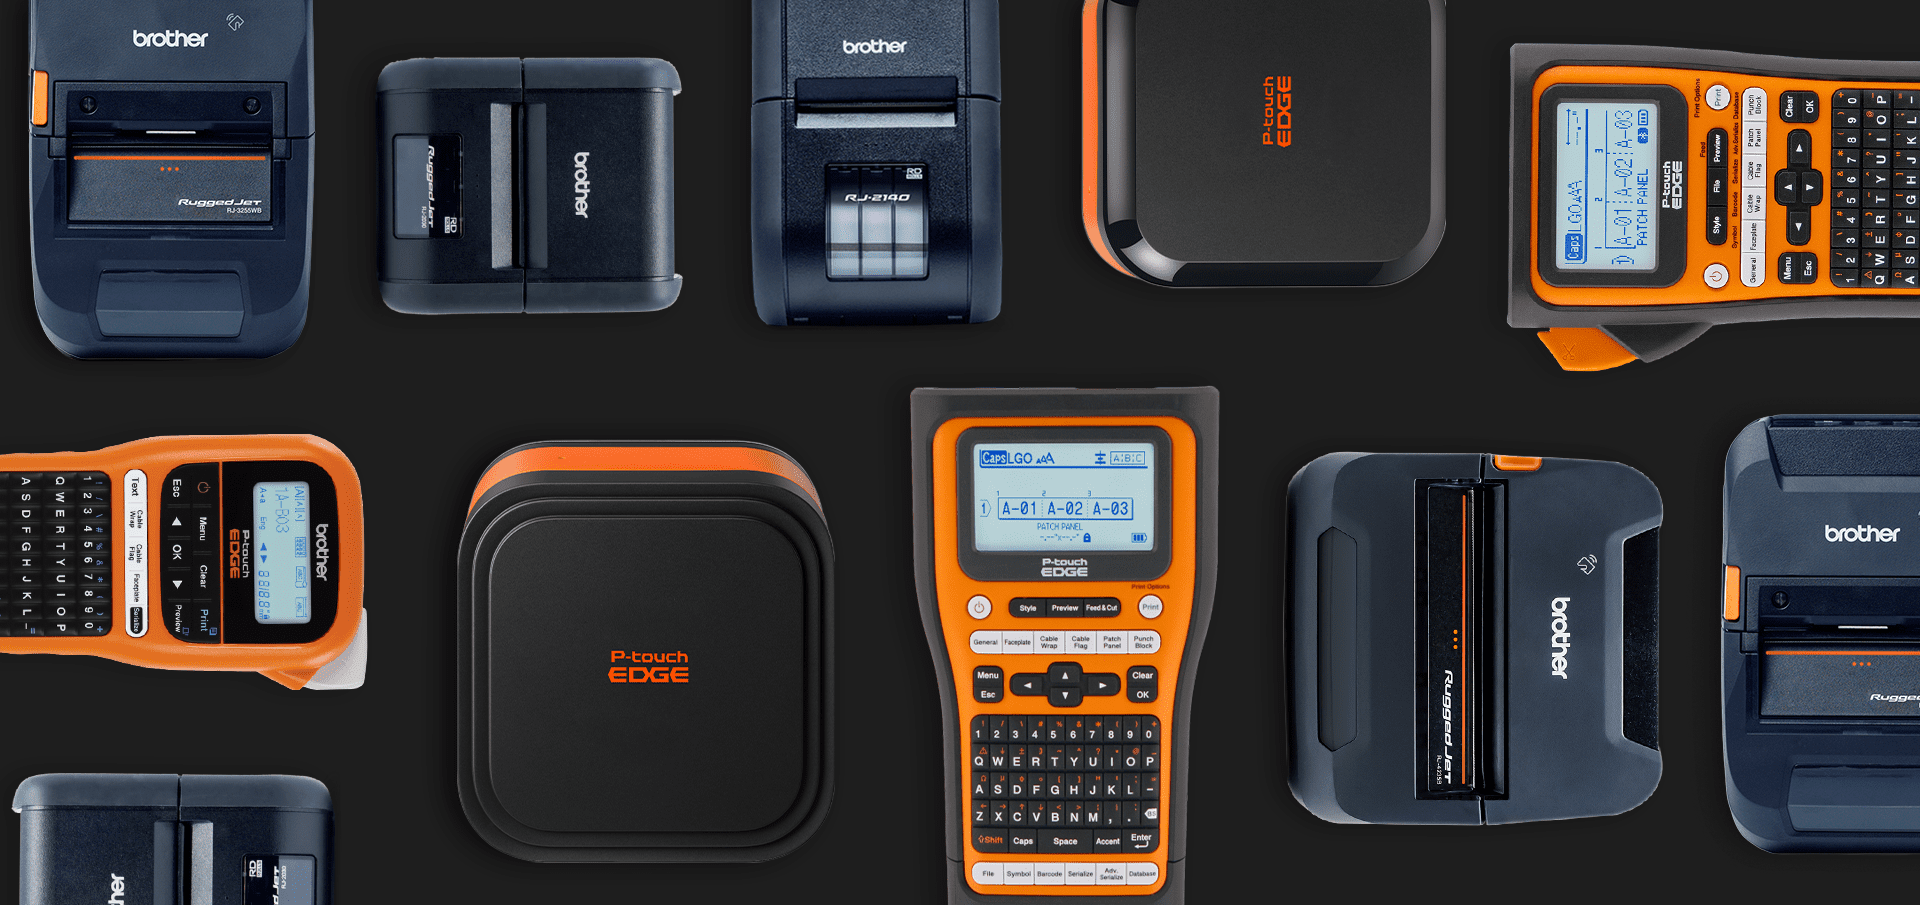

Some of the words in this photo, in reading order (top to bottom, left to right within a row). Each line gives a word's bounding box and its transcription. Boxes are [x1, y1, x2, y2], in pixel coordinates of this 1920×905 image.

[133, 30, 208, 47] brother
[843, 39, 907, 54] brother
[1785, 95, 1794, 118] Clear
[1876, 95, 1887, 104] P
[1263, 76, 1274, 145] P-touch
[1277, 76, 1292, 148] EDGE
[1805, 100, 1814, 114] OK
[1876, 115, 1887, 125] O
[1614, 110, 1633, 149] A-03
[1713, 134, 1721, 162] Preview
[1876, 155, 1887, 164] U
[1614, 158, 1633, 197] A-02
[1662, 161, 1671, 208] P-touch
[1876, 175, 1886, 183] Y
[574, 152, 590, 218] brother
[1637, 168, 1649, 205] PANEL
[1671, 160, 1683, 210] EDGE
[1713, 179, 1721, 193] File
[845, 194, 910, 202] RJ-2140
[450, 217, 457, 233] RD
[1713, 216, 1722, 234] Style
[1875, 215, 1885, 224] R
[1614, 209, 1633, 246] A-01
[1636, 209, 1648, 246] PATCH
[1565, 233, 1583, 260] Caps
[1875, 236, 1885, 244] E
[1875, 253, 1885, 266] W
[1784, 257, 1792, 280] Menu
[1804, 260, 1812, 276] Esc
[1874, 275, 1885, 285] Q
[982, 451, 1007, 465] Caps
[1007, 452, 1033, 464] LGO
[55, 476, 65, 485] Q
[131, 477, 140, 496] Text
[172, 478, 182, 498] Esc
[55, 491, 65, 503] W
[55, 509, 65, 518] E
[1002, 501, 1036, 516] A-01
[1047, 501, 1083, 516] A-02
[1092, 501, 1129, 516] A-03
[55, 526, 65, 534] R
[199, 516, 207, 541] Menu
[259, 516, 267, 530] Eng
[1037, 522, 1060, 531] PATCH
[1061, 522, 1083, 531] PANEL
[1824, 524, 1901, 542] brother
[172, 544, 182, 560] OK
[229, 528, 240, 579] EDGE
[242, 529, 250, 578] P-touch
[315, 523, 329, 581] brother
[56, 558, 66, 566] Y
[1042, 558, 1088, 566] P-touch
[56, 574, 66, 583] U
[200, 564, 208, 589] Clear
[1040, 567, 1089, 577] EDGE
[132, 573, 141, 603] Faceplate
[56, 607, 66, 616] O
[1019, 604, 1037, 612] Style
[1051, 604, 1079, 612] Preview
[174, 604, 182, 633] Preview
[200, 609, 209, 632] Print
[56, 624, 66, 632] P
[1551, 596, 1571, 680] brother
[1040, 642, 1058, 650] Wrap
[1073, 642, 1088, 650] Flag
[611, 650, 689, 663] P-touch
[608, 666, 689, 683] EDGE
[977, 671, 999, 679] Menu
[1132, 671, 1153, 679] Clear
[1136, 691, 1149, 699] OK
[974, 757, 984, 767] Q
[992, 757, 1004, 767] W
[1013, 757, 1021, 767] E
[1032, 757, 1040, 767] R
[1051, 757, 1059, 767] T
[1070, 757, 1079, 767] Y
[1089, 757, 1098, 767] U
[1126, 757, 1136, 767] O
[1146, 757, 1154, 767] P
[984, 836, 1003, 844] Shift
[1013, 838, 1034, 846] Caps
[1053, 838, 1078, 846] Space
[1131, 834, 1152, 842] Enter
[249, 860, 257, 877] RD
